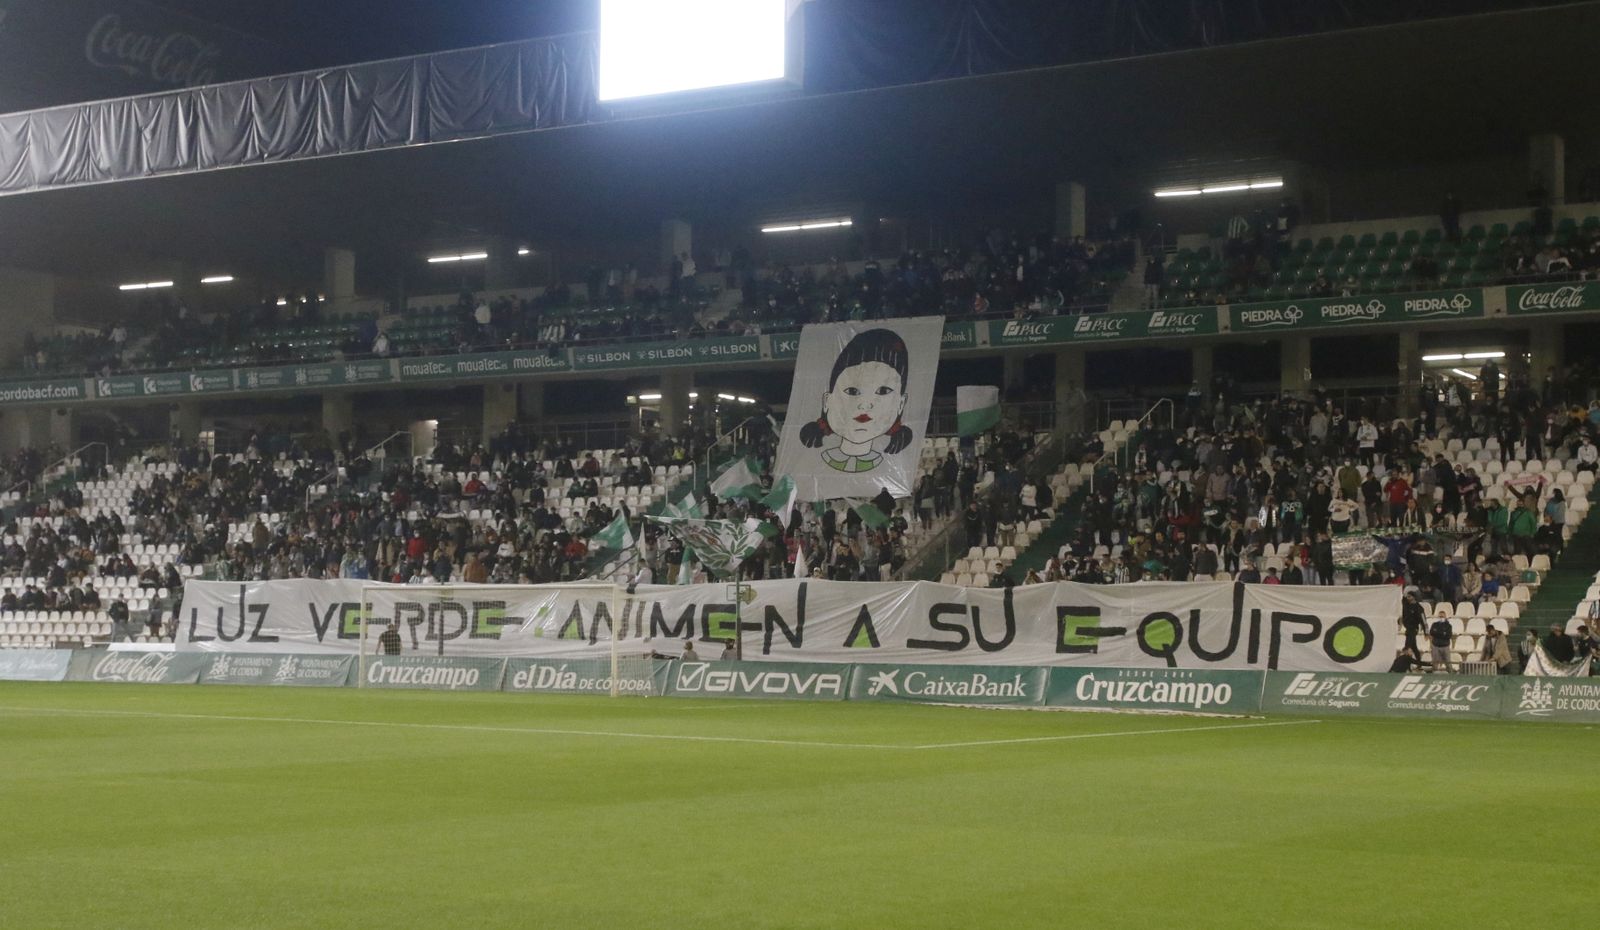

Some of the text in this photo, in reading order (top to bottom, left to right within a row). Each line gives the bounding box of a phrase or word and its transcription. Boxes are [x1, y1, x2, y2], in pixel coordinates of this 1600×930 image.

[1091, 318, 1128, 331] PACC
[1165, 313, 1201, 326] PACC
[1019, 323, 1052, 336] PACC
[647, 348, 693, 359] SILBON
[710, 343, 758, 355] SILBON
[587, 351, 631, 363] SILBON
[189, 584, 279, 643] LUZ
[558, 582, 807, 655] ANIMEN
[843, 604, 880, 648] A
[907, 586, 1016, 652] SU
[1056, 582, 1374, 671] EQUIPO
[367, 658, 479, 690] Cruzcampo
[578, 678, 593, 690] DE
[704, 671, 841, 695] GIVOVA
[903, 671, 1027, 697] CaixaBank
[1313, 681, 1379, 698] PACC
[1076, 672, 1232, 709] Cruzcampo
[1420, 684, 1489, 702] PACC
[1318, 698, 1327, 706] de
[1328, 698, 1360, 708] Seguros
[1425, 701, 1435, 710] de
[1436, 702, 1470, 712] Seguros
[1556, 698, 1569, 710] DE
